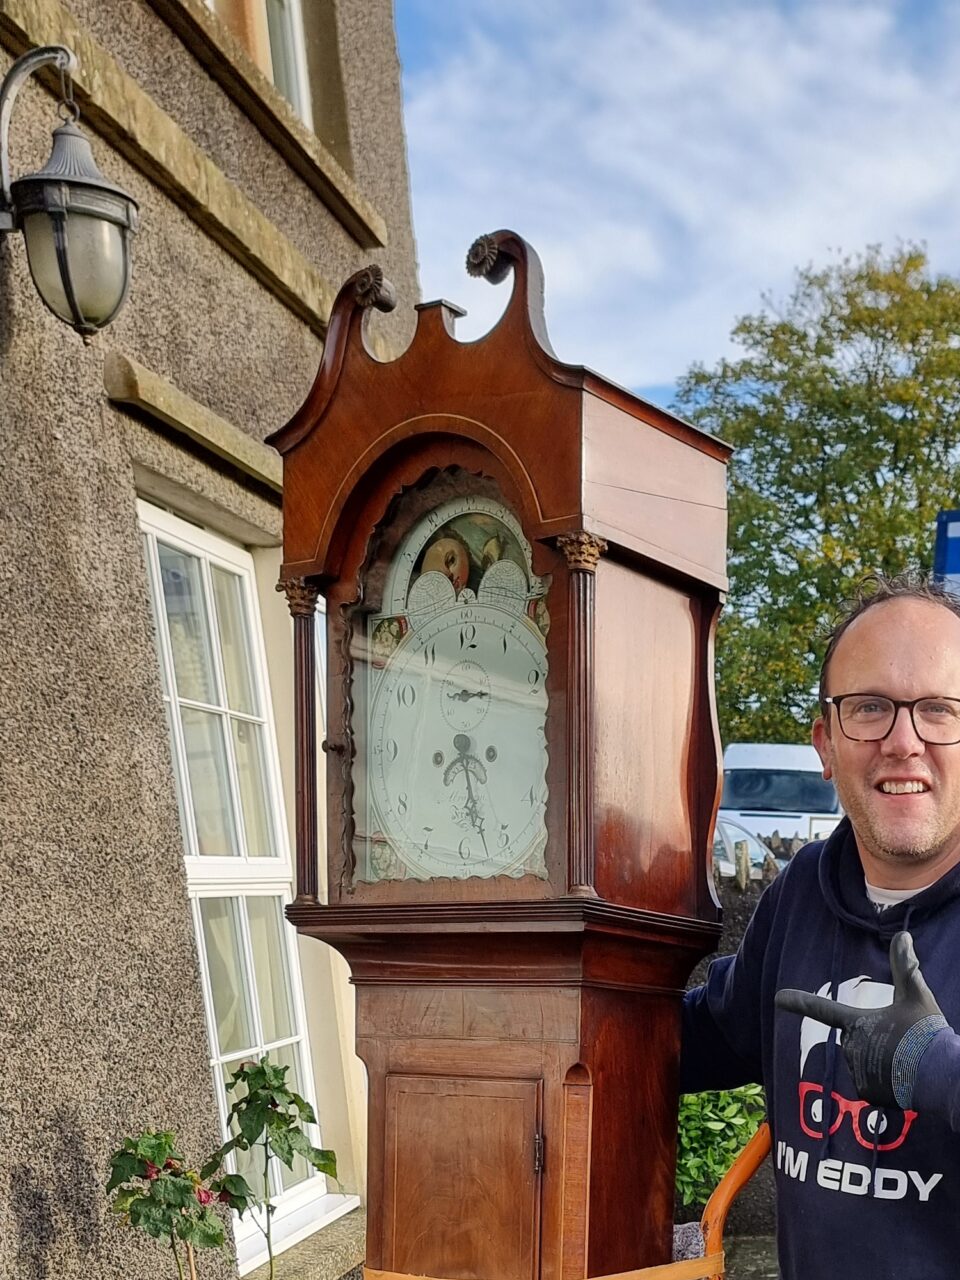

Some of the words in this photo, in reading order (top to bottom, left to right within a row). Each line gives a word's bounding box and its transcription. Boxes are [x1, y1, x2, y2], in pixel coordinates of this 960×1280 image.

[460, 609, 473, 620] 60
[460, 624, 477, 650] 12
[502, 633, 508, 655] 1
[424, 643, 436, 666] 11
[527, 669, 540, 695] 2
[396, 683, 416, 708] 10
[386, 739, 398, 762] 9
[397, 791, 408, 815] 8
[520, 784, 538, 808] 4
[458, 836, 471, 860] 6
[777, 1141, 809, 1182] I'M
[817, 1158, 943, 1201] EDDY
